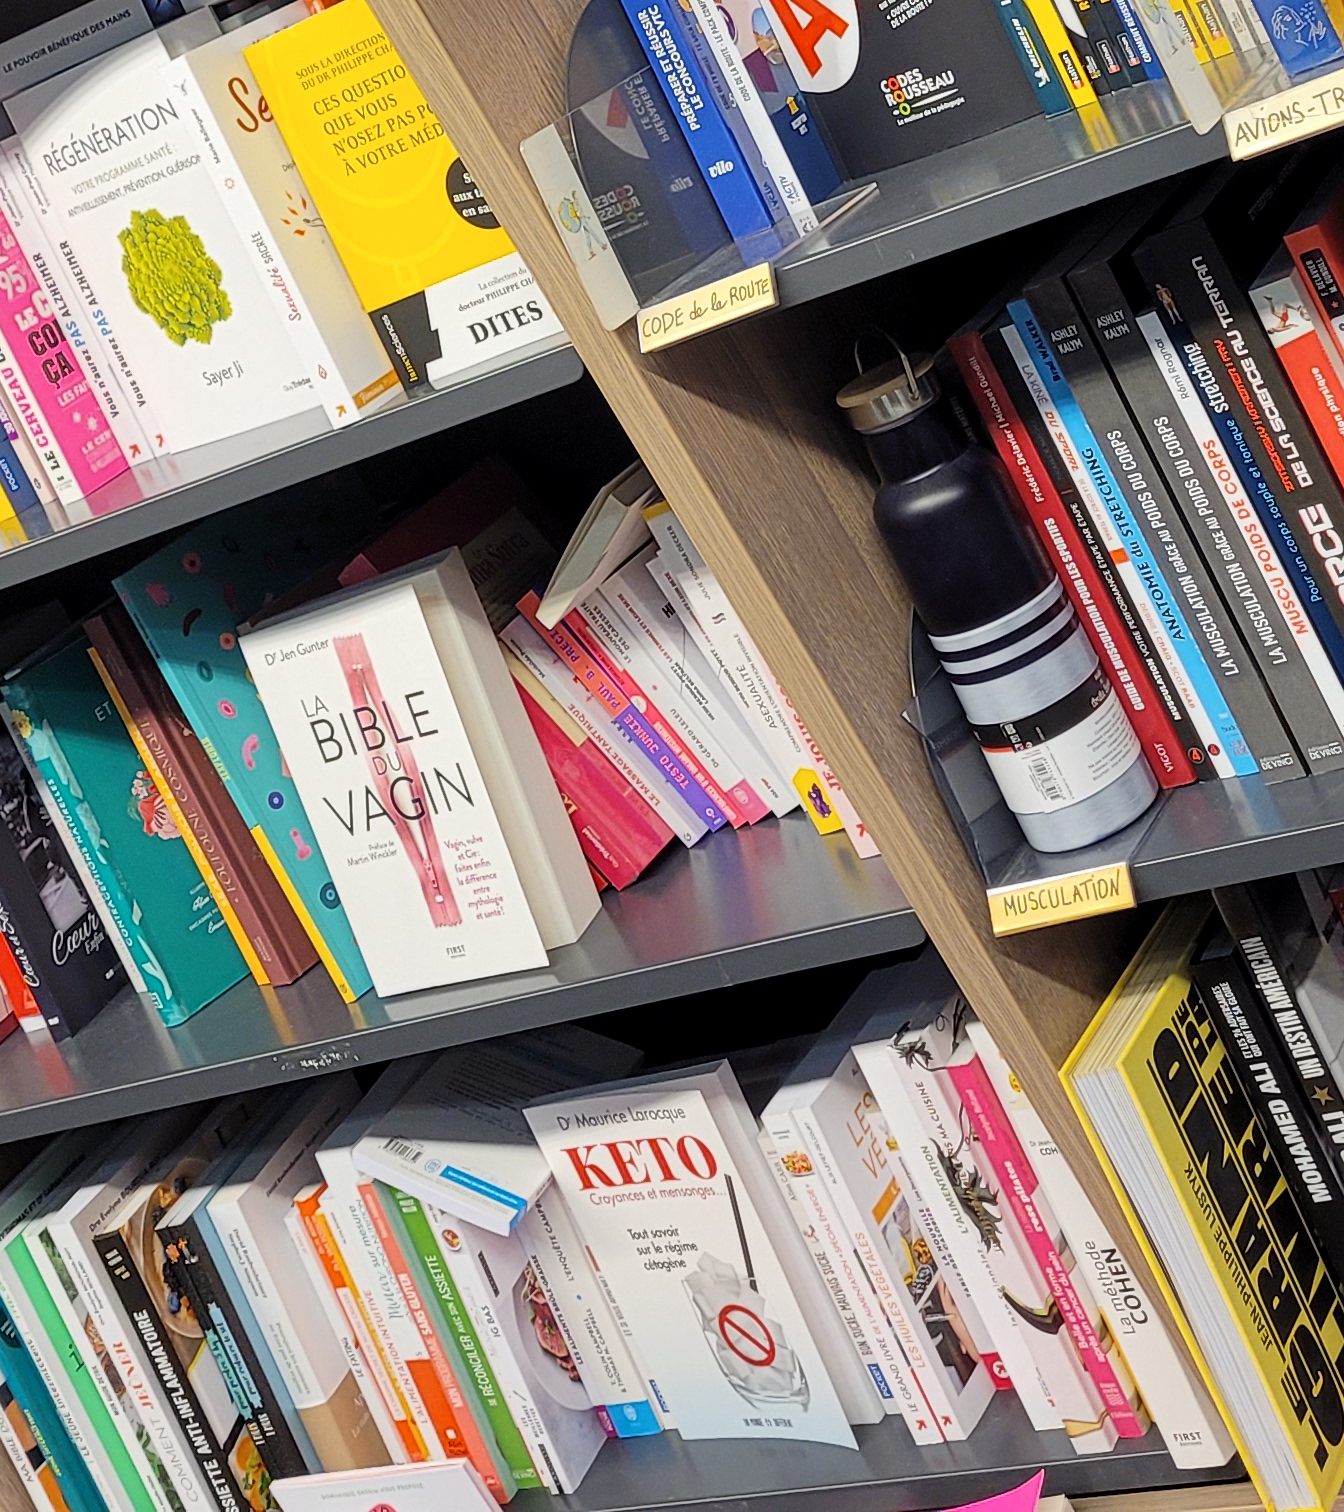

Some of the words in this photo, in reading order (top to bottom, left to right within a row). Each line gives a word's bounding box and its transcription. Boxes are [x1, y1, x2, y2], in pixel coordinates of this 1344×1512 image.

[42, 98, 178, 176] RÉGÉNÉRATION
[323, 110, 356, 137] QUE
[356, 92, 399, 121] VOUS
[707, 159, 734, 178] vilo
[467, 300, 543, 344] DITES
[641, 311, 684, 339] CODE
[689, 301, 708, 324] de
[707, 293, 727, 318] la
[729, 275, 772, 308] ROUTE
[299, 695, 331, 721] LA
[309, 689, 440, 764] BIBLE
[373, 750, 403, 776] DU
[322, 762, 475, 837] VAGIN
[1002, 872, 1122, 918] MUSCULATION
[1249, 1055, 1282, 1094] ALI
[575, 1107, 624, 1129] Maurice
[627, 1105, 687, 1128] Larocque
[559, 1135, 720, 1191] KETO
[1268, 1099, 1334, 1204] MOHAMED
